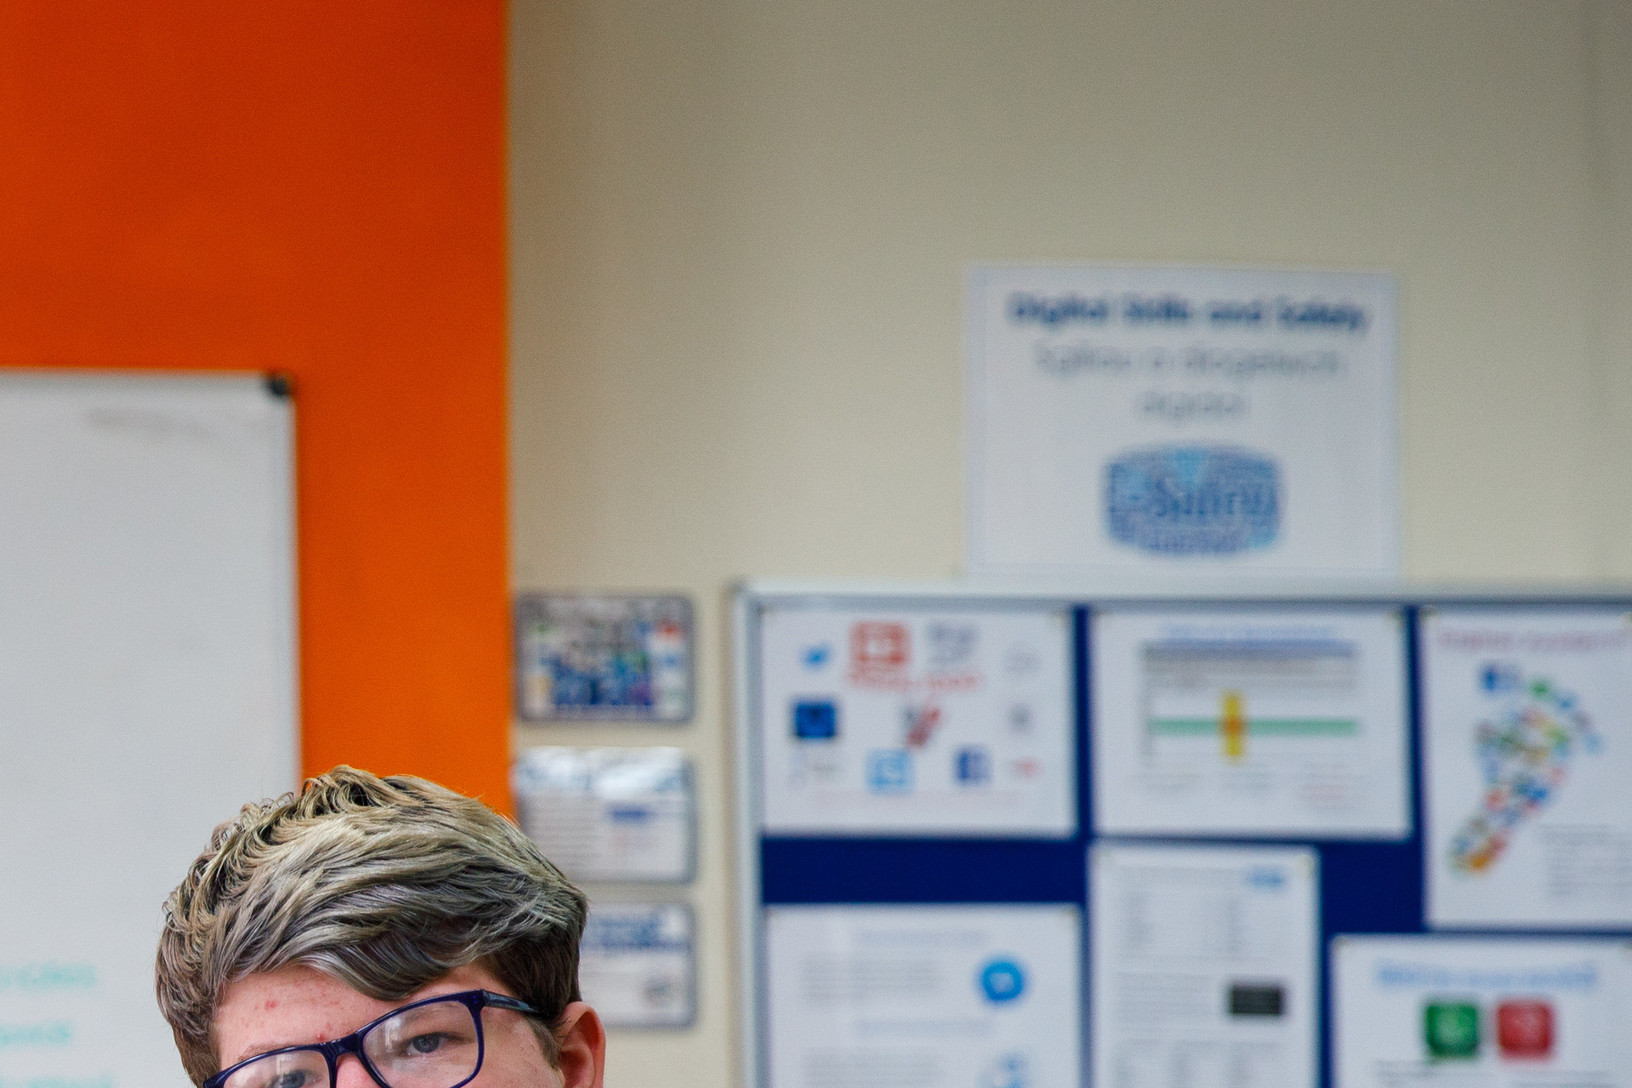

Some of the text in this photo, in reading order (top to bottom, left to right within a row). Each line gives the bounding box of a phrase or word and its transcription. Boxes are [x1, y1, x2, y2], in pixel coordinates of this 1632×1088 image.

[1008, 294, 1370, 336] Digital Skills and Safety
